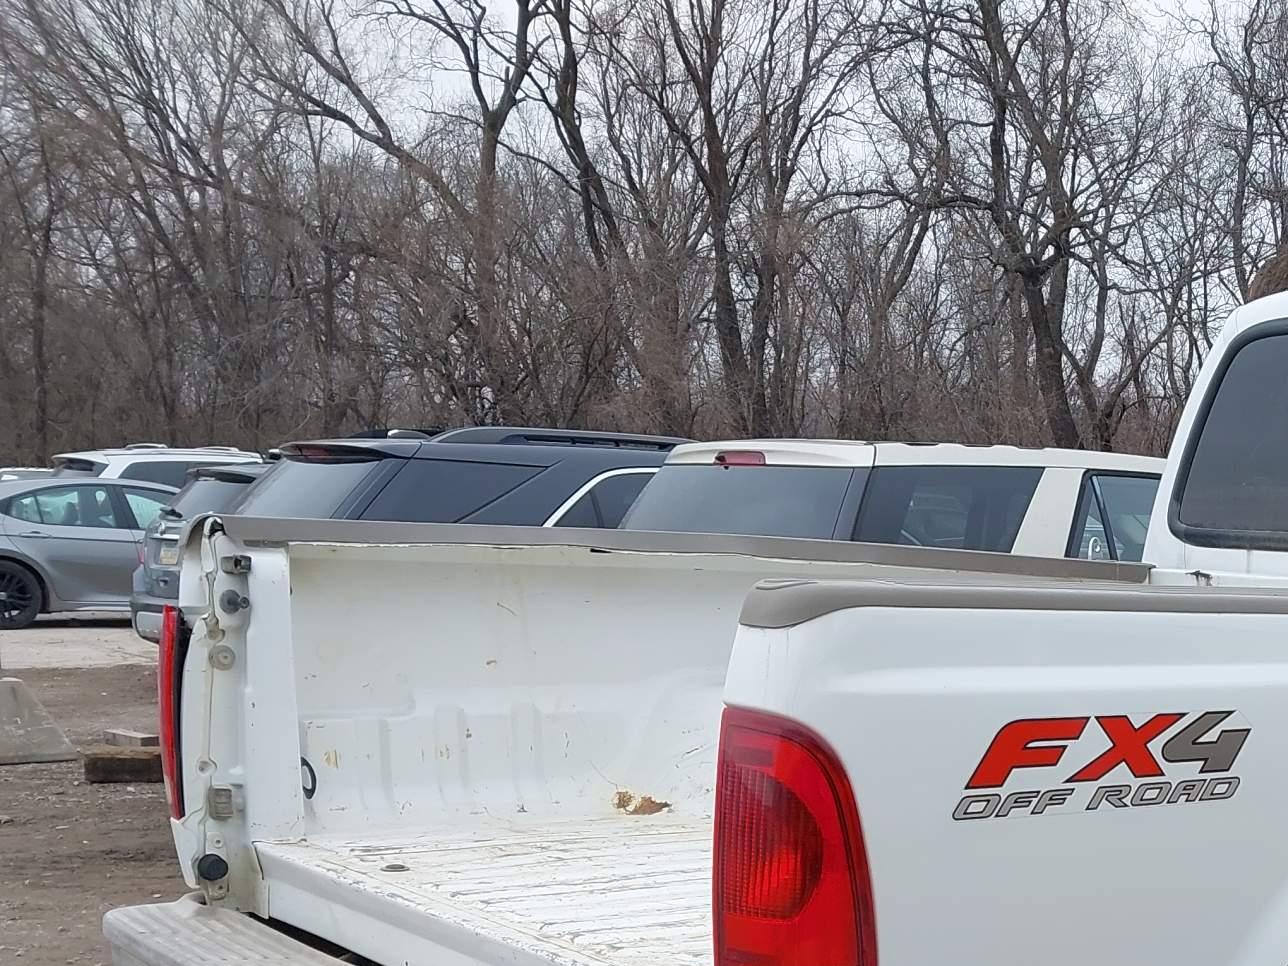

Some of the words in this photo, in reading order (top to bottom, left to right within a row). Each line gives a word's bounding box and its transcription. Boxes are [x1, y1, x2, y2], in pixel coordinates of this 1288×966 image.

[964, 710, 1252, 790] FX4
[952, 788, 1075, 821] OFF
[1085, 777, 1240, 811] ROAD
